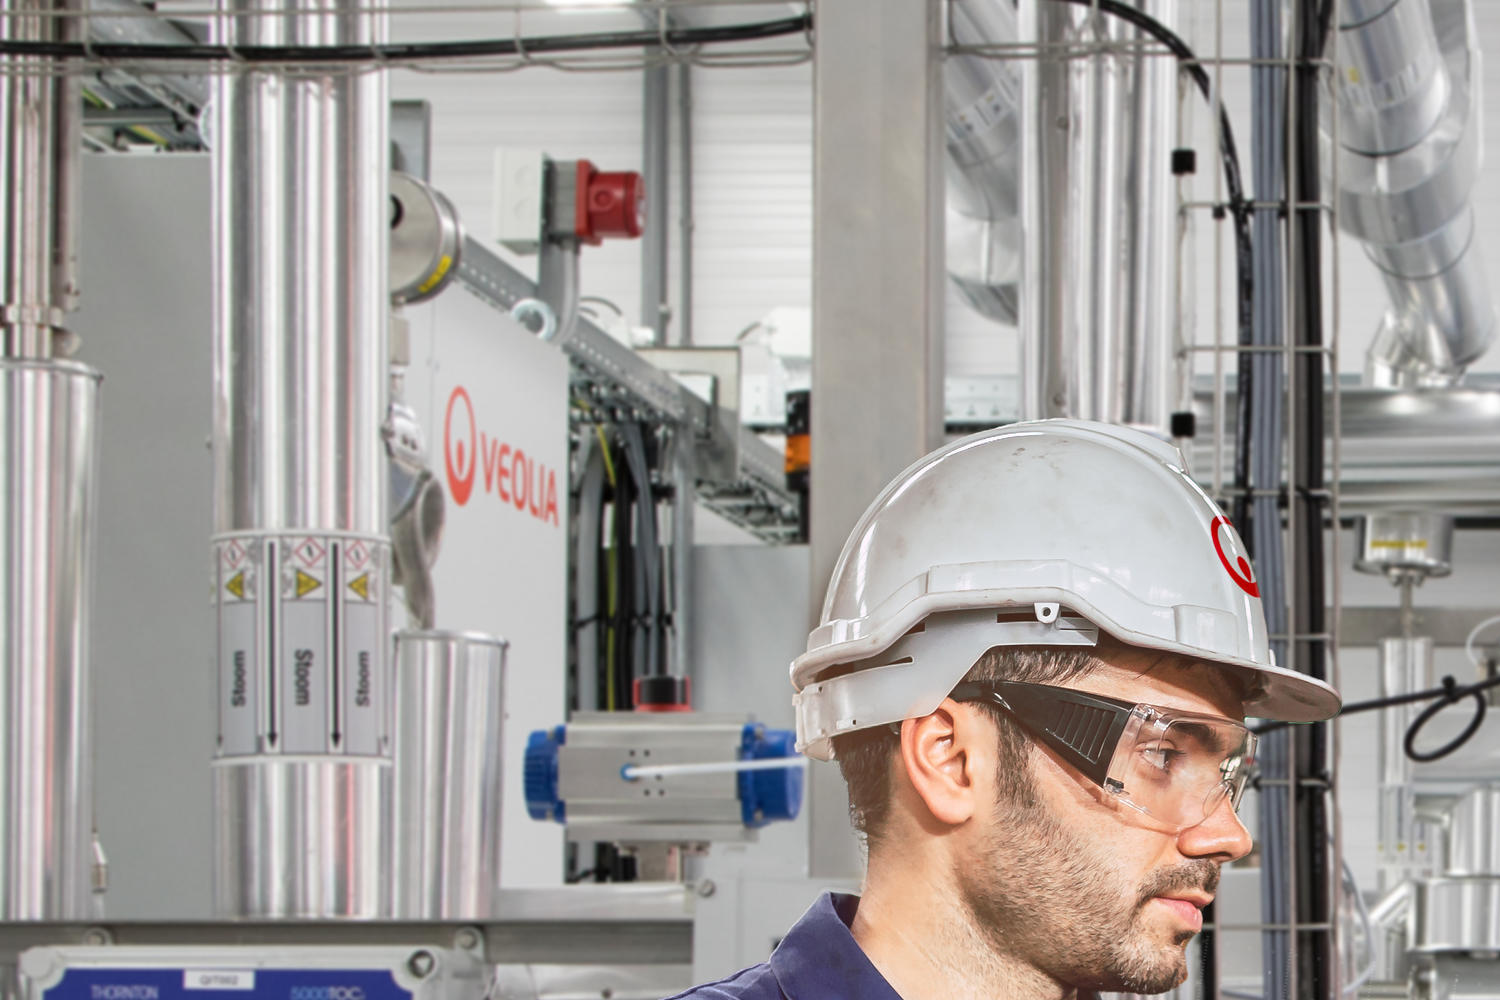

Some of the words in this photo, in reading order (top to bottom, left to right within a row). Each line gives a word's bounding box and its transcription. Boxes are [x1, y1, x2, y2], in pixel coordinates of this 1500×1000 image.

[480, 430, 560, 529] VEOLIA
[231, 650, 246, 708] Stoom
[295, 649, 314, 707] Stoom
[355, 651, 370, 708] Stoom
[91, 985, 159, 1000] THORNTON
